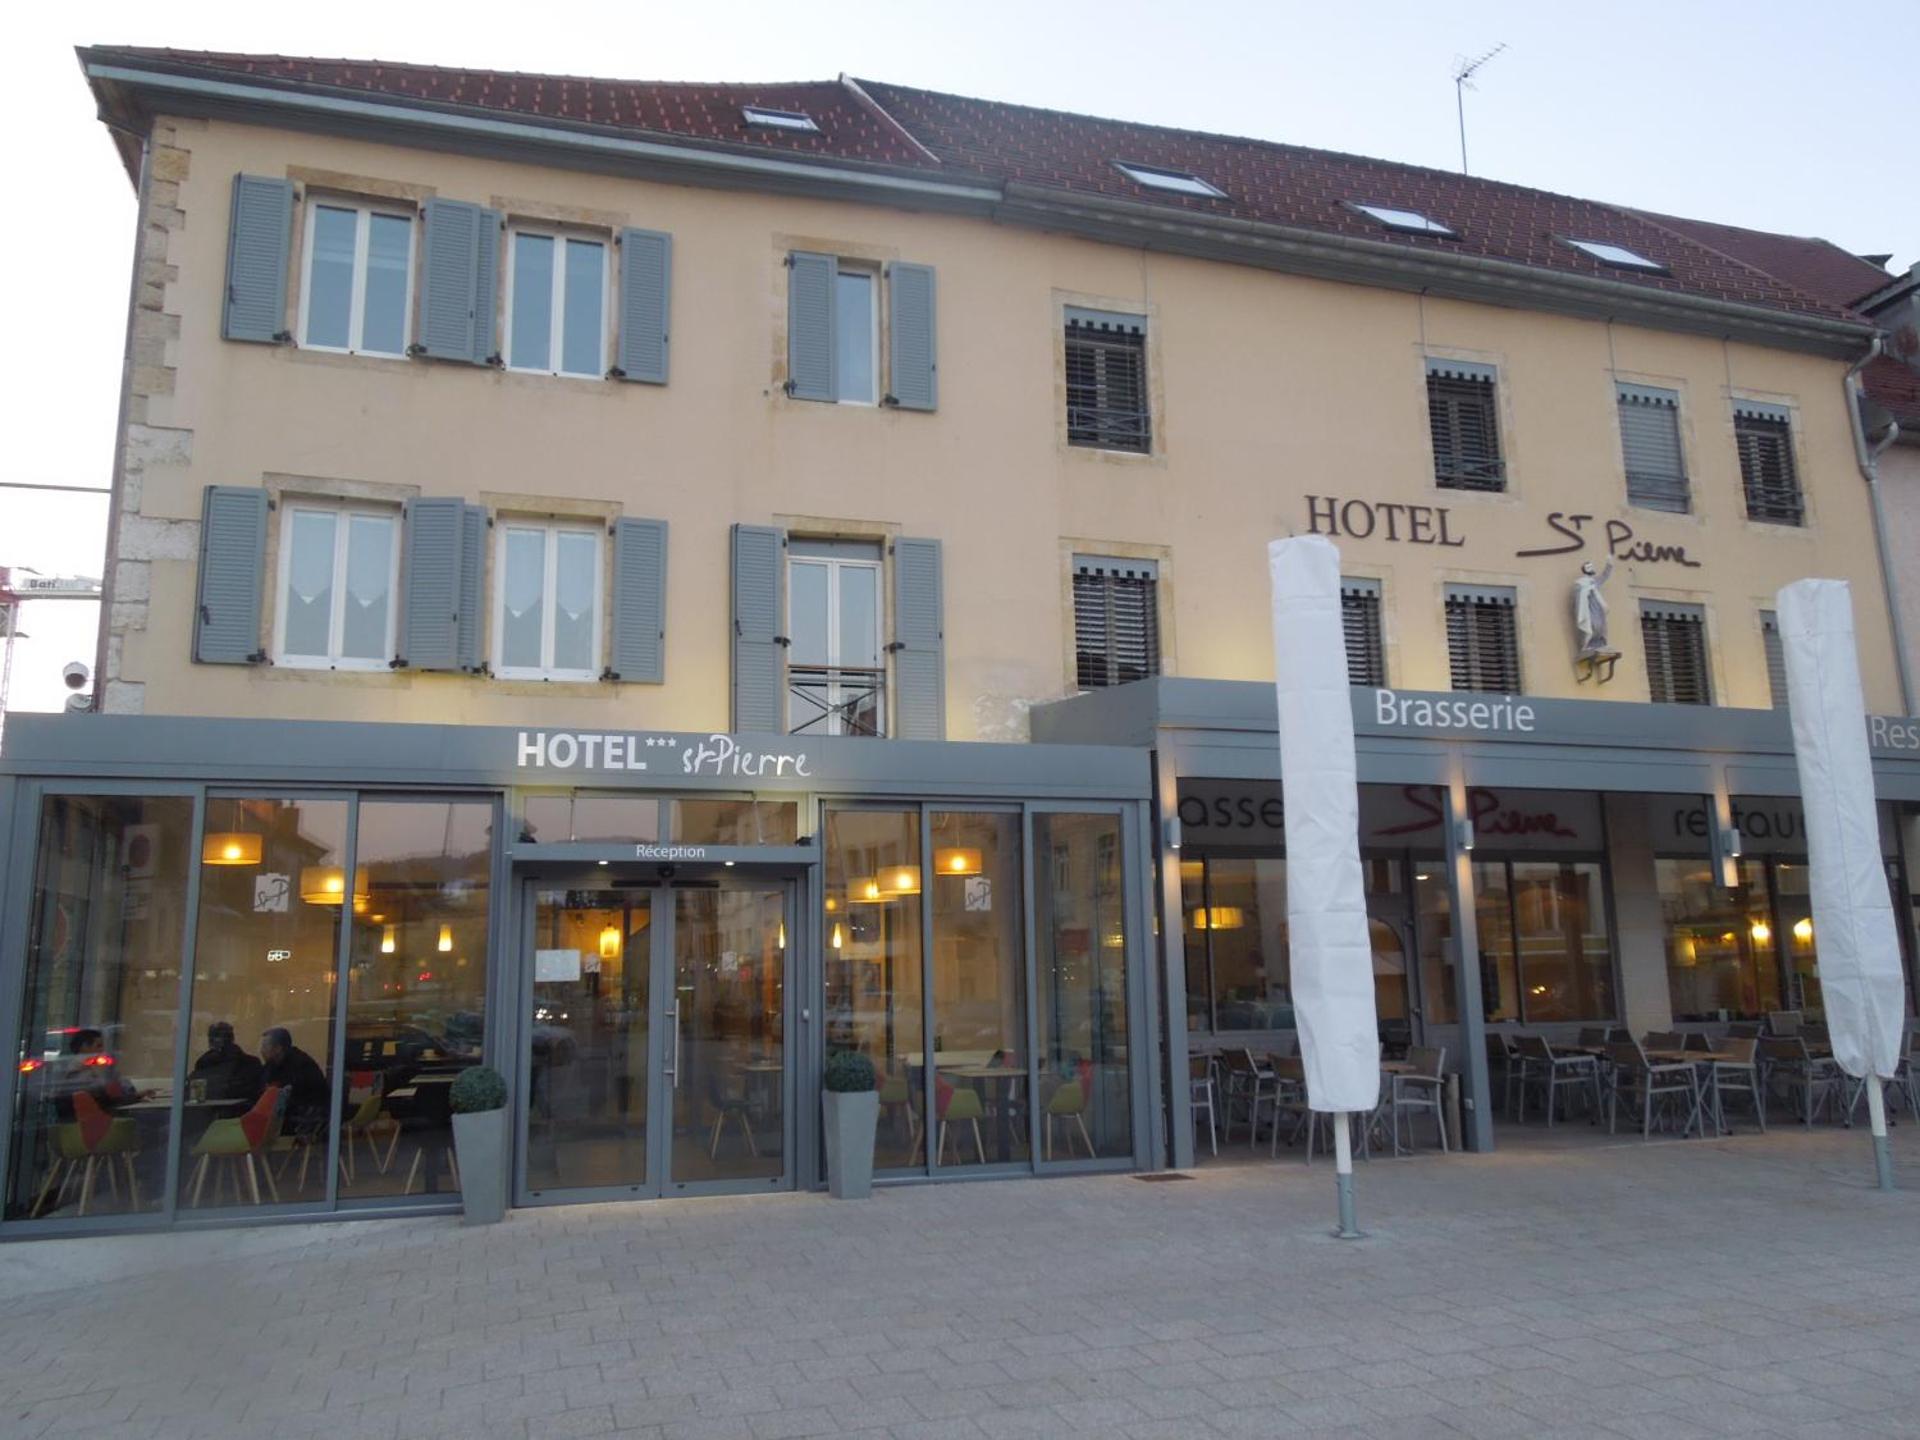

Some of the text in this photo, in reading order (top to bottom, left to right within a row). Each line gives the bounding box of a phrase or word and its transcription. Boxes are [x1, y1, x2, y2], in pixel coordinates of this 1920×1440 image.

[1305, 496, 1465, 547] HOTEL
[1375, 688, 1536, 733] Brasserie
[517, 732, 647, 770] HOTEL
[636, 844, 705, 859] Réception
